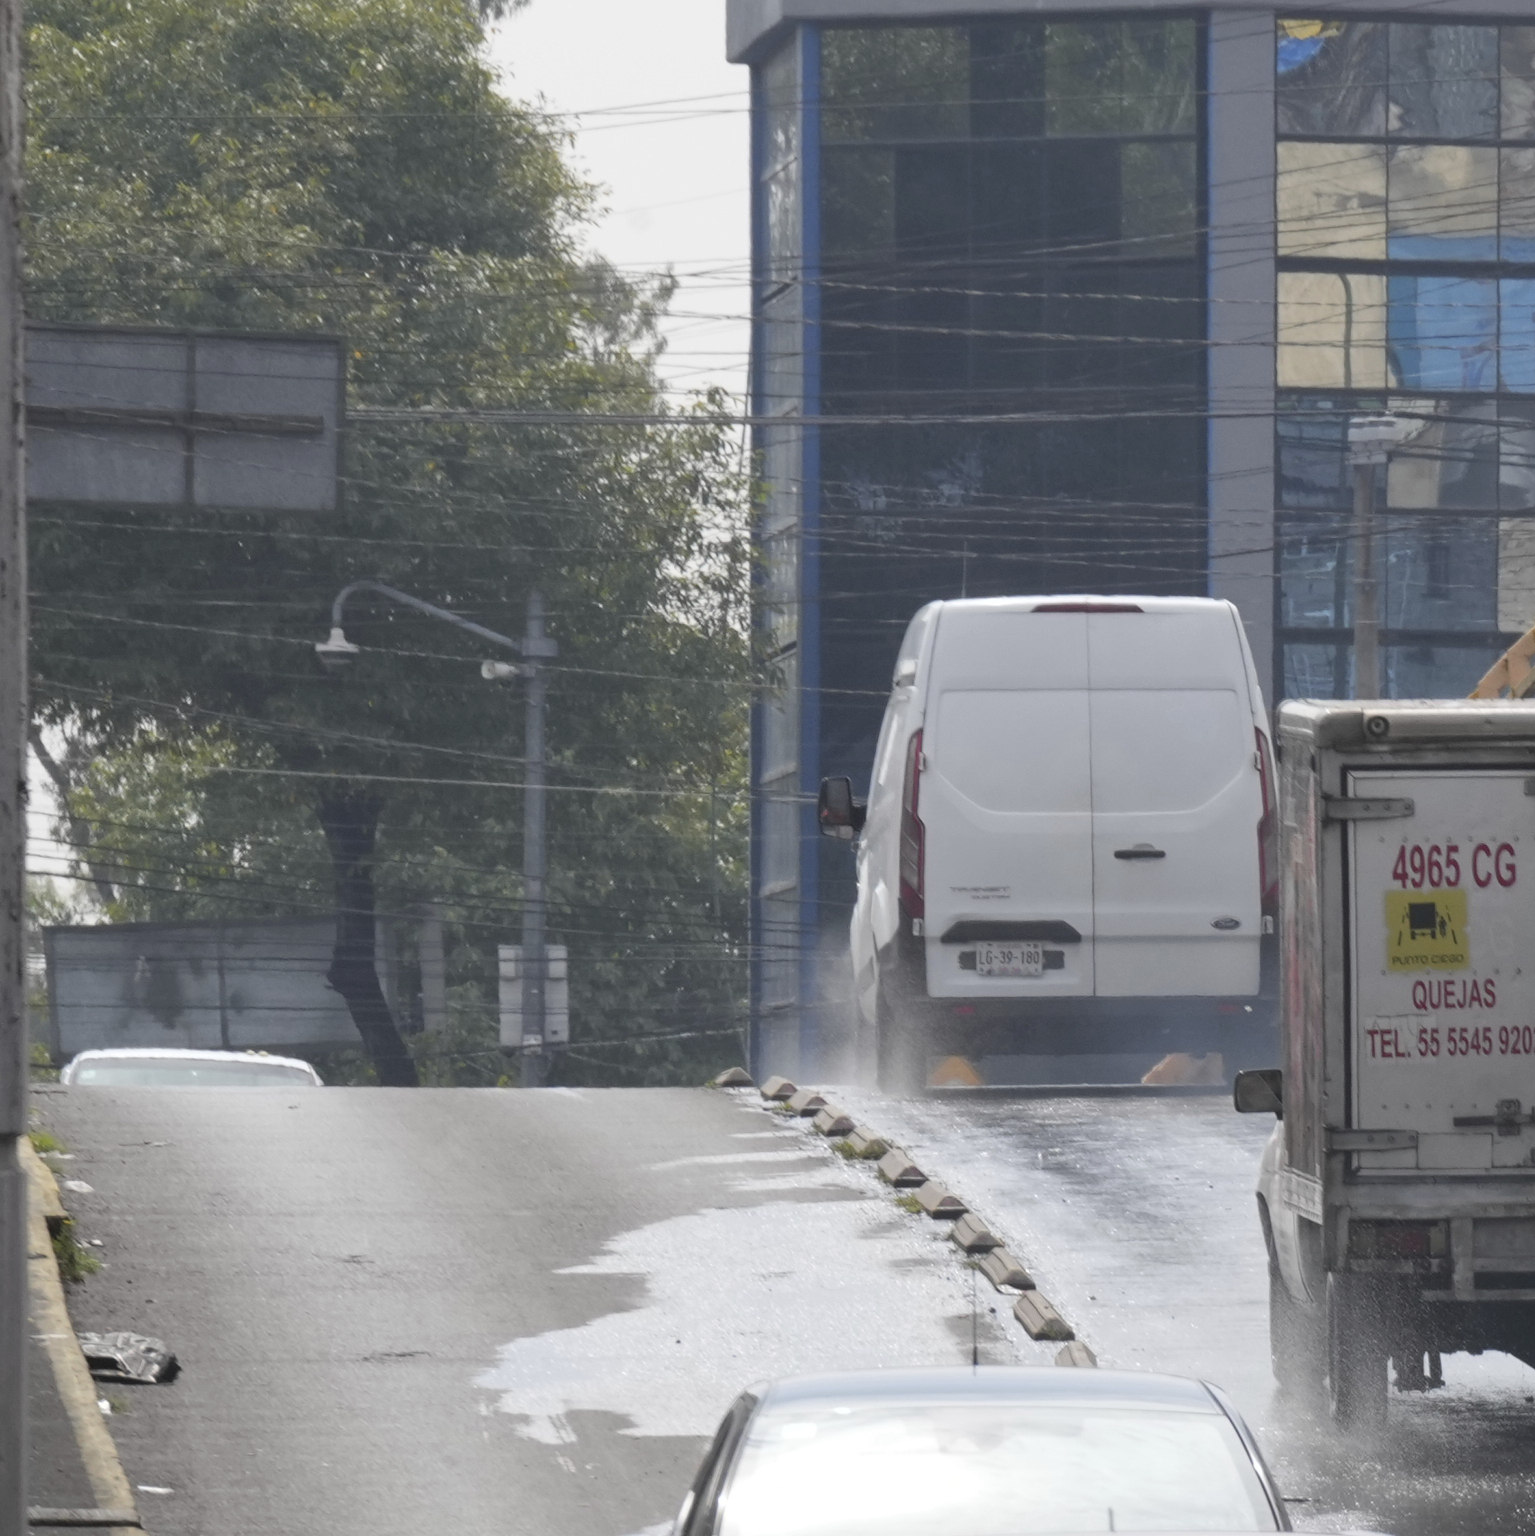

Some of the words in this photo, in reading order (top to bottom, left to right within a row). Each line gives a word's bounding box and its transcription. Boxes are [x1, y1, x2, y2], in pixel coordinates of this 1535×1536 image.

[1392, 844, 1461, 889] 4965
[1472, 843, 1517, 888] CG
[979, 950, 1040, 964] LG-39-180
[1391, 955, 1429, 966] PUNTO
[1431, 954, 1464, 964] CIEGO
[1412, 978, 1496, 1012] QUEJAS
[1366, 1029, 1411, 1059] TEL.
[1418, 1028, 1440, 1057] 55
[1447, 1026, 1493, 1056] 5545
